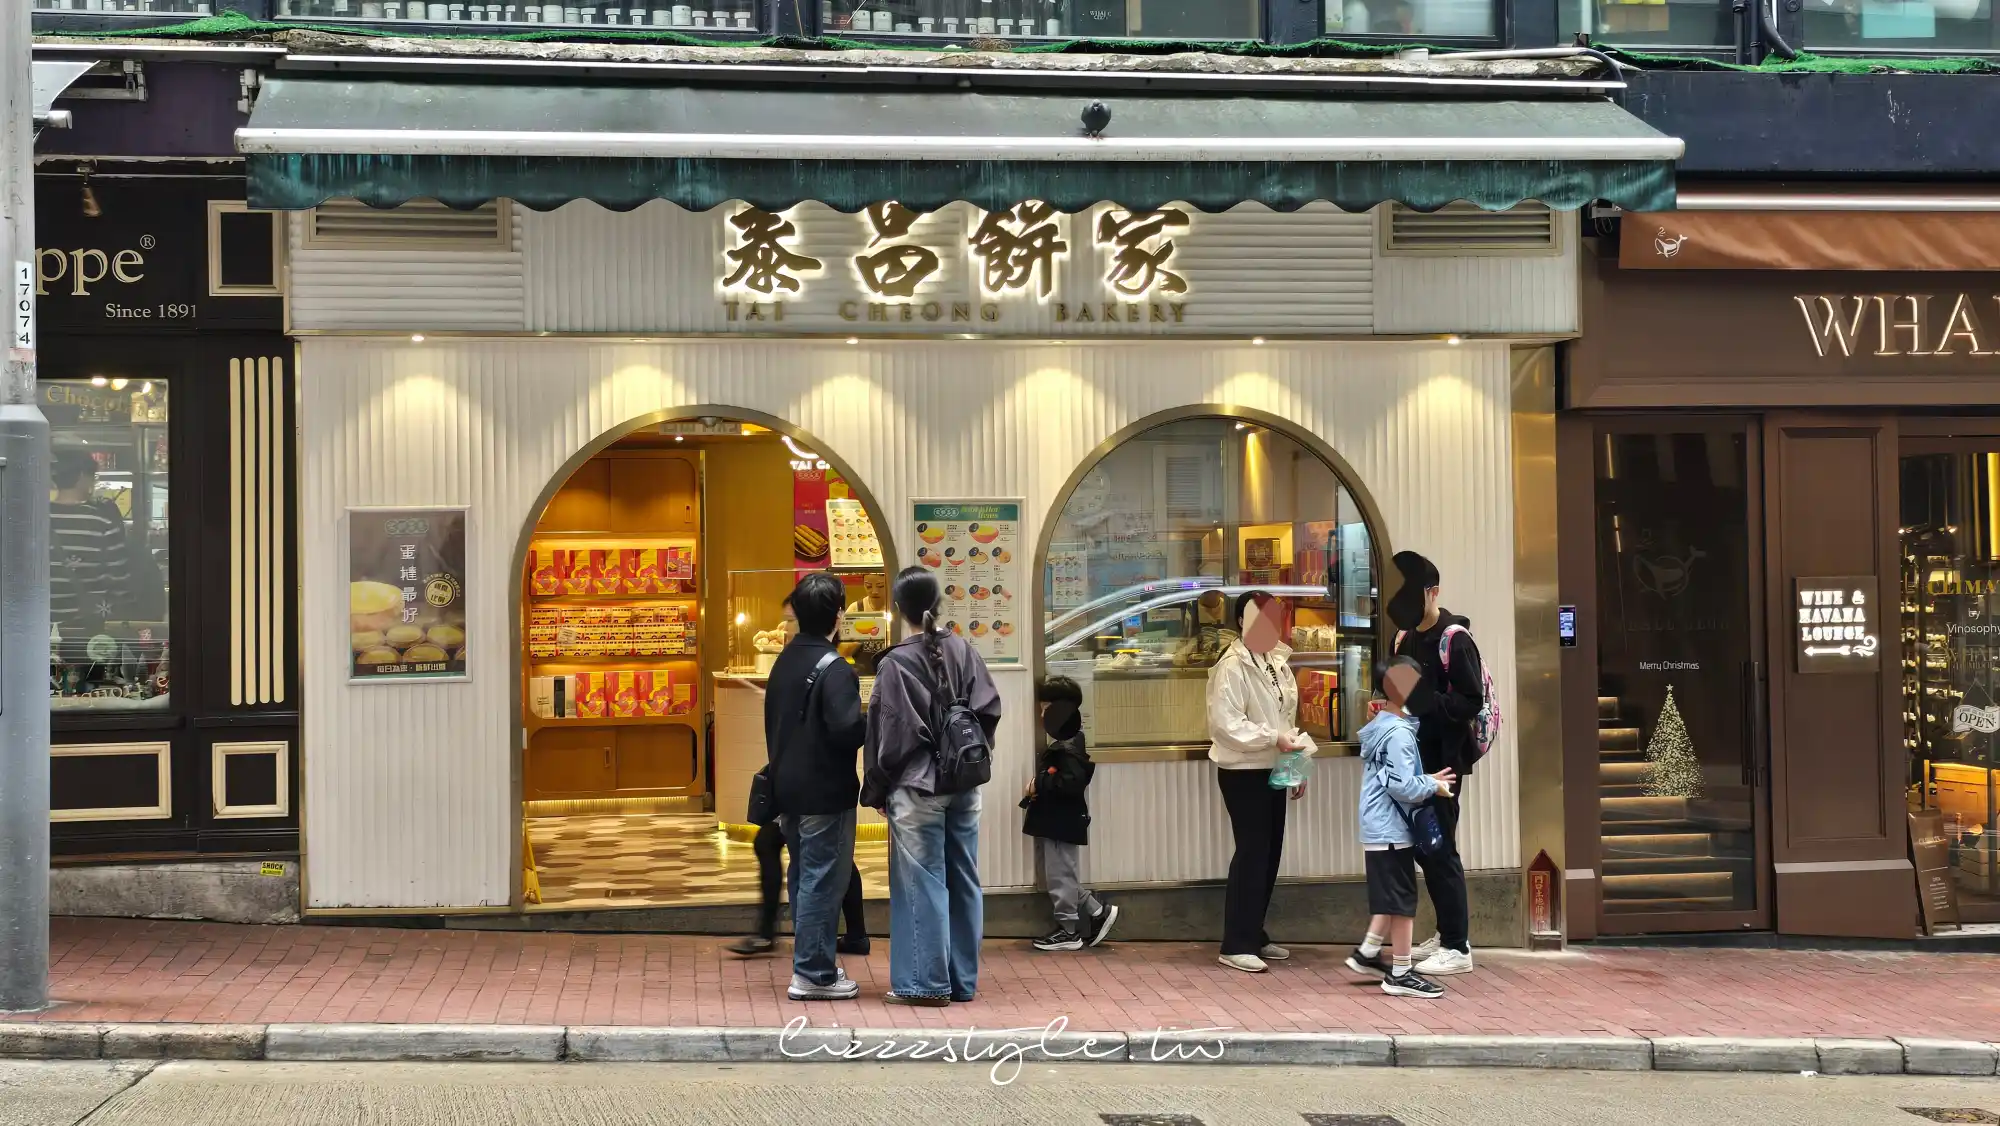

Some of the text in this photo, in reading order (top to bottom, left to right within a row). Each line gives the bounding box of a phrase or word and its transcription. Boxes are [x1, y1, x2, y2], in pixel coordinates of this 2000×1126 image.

[722, 200, 1190, 298] 泰昌餅家
[105, 303, 196, 318] Since 1891
[723, 301, 1188, 323] TAI CHEONG BAKERY
[1793, 293, 2000, 357] WHA
[790, 461, 813, 471] TAI
[1927, 579, 2000, 596] CLIMA
[1800, 589, 1865, 606] WINE &
[1799, 607, 1866, 624] HAVANA
[1968, 608, 1981, 620] by
[1802, 626, 1865, 641] LOUNGE
[1640, 660, 1700, 671] Merry Christmas
[1959, 712, 1994, 729] OPEN
